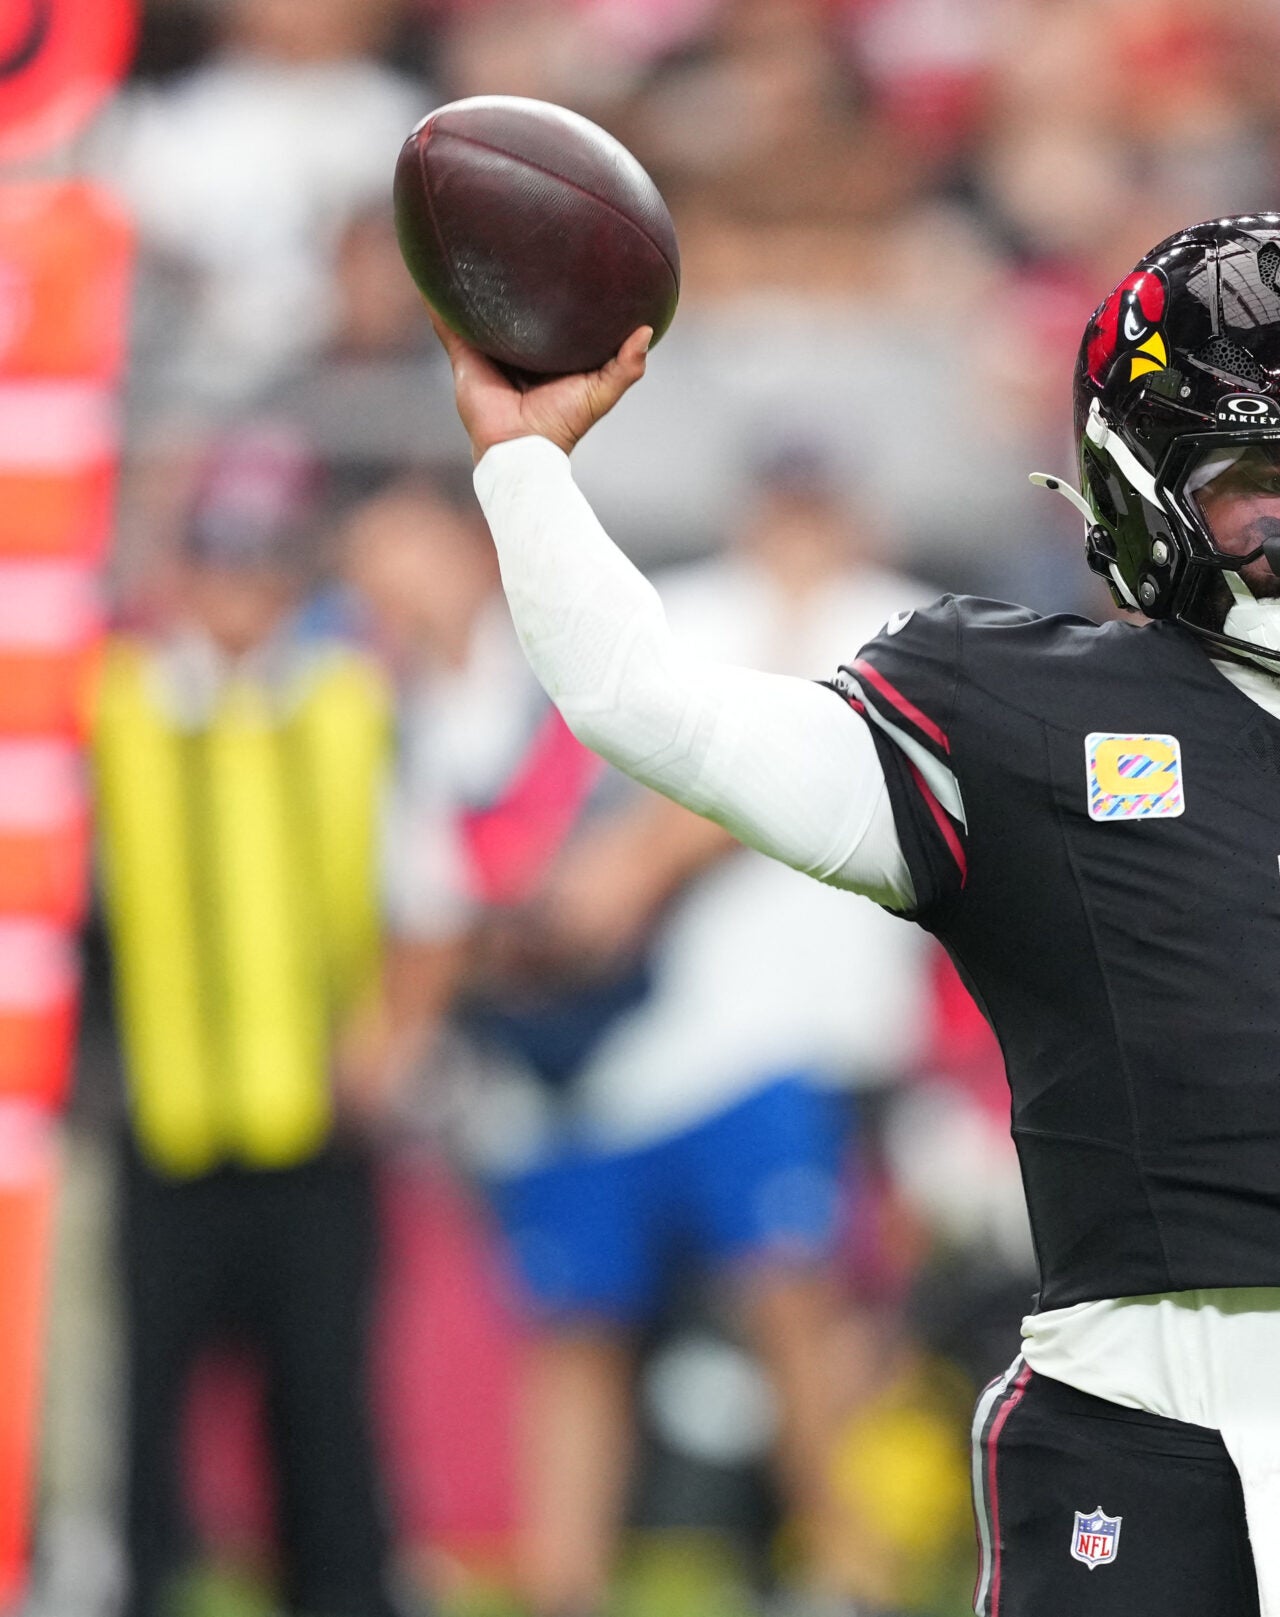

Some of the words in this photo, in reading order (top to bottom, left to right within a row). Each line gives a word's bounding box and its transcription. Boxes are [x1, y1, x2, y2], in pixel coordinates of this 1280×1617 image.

[1218, 412, 1279, 425] OAKLEY
[1095, 739, 1177, 795] C
[1078, 1533, 1110, 1557] NFL
